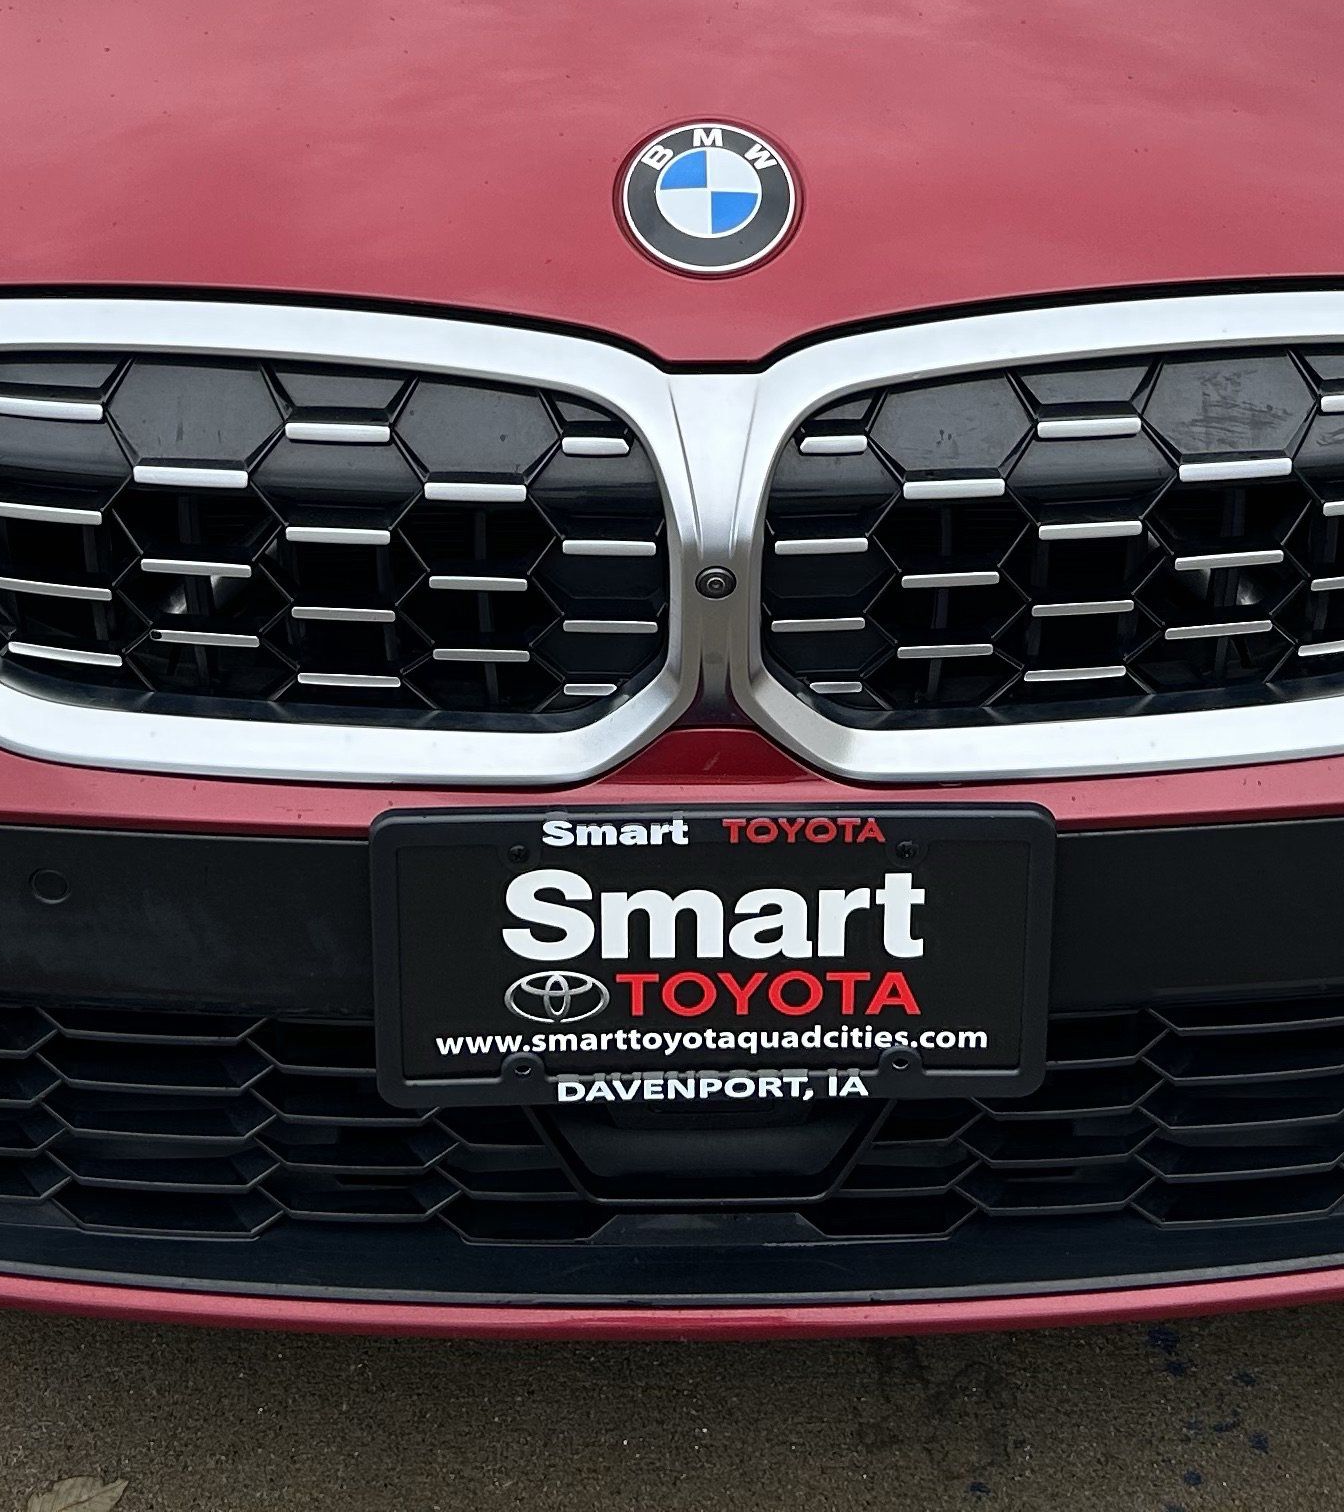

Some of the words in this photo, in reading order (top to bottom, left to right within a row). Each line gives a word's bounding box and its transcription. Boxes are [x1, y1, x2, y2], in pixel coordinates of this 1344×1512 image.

[641, 128, 778, 171] BMW
[541, 819, 689, 847] Smart
[722, 818, 886, 844] TOYOTA
[502, 869, 926, 962] Smart
[615, 970, 922, 1018] TOYOTA
[435, 1025, 988, 1055] www.smarttoyotaquadcities.com
[557, 1076, 815, 1102] DAVENPORT,
[827, 1075, 870, 1097] IA
